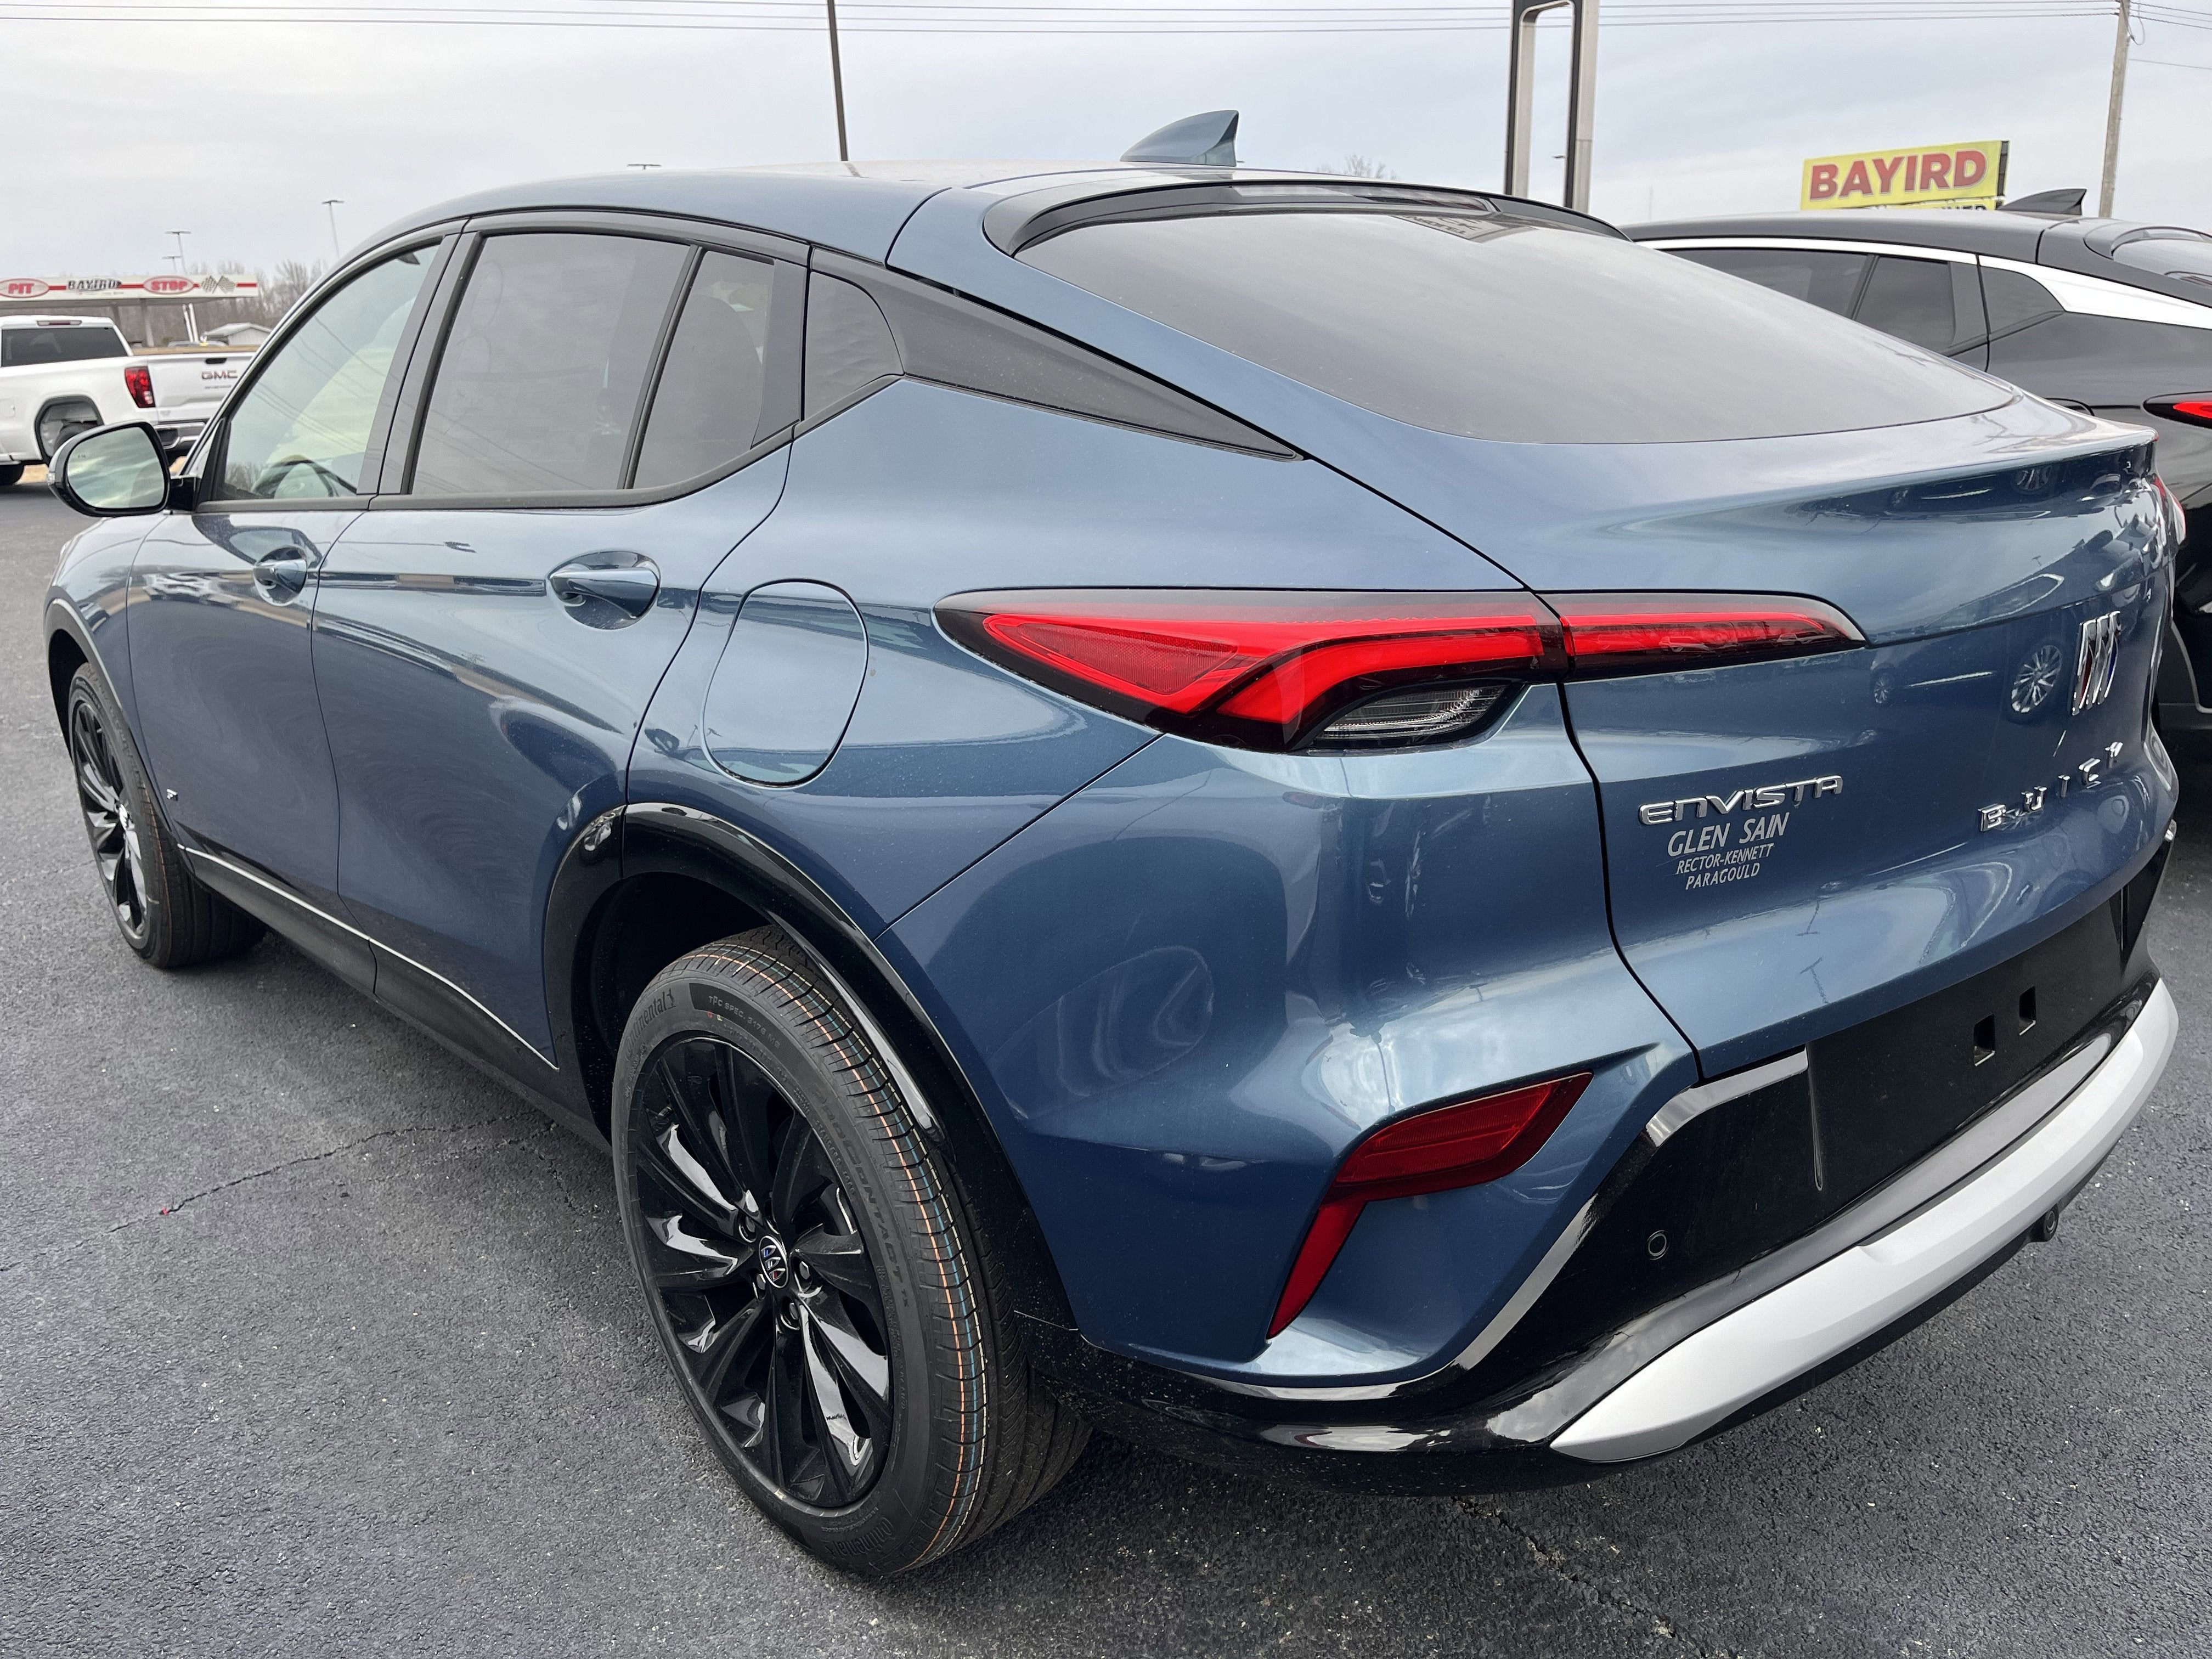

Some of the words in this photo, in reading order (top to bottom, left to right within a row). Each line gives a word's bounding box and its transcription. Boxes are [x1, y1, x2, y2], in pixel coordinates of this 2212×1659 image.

[1809, 149, 1988, 201] BAYIRD
[8, 282, 35, 295] PIT
[67, 279, 122, 291] BAYIRD
[151, 280, 188, 291] STOP
[201, 369, 238, 379] GMC
[1638, 775, 1843, 826] ENVISTA
[1667, 823, 1731, 857] GLEN
[1739, 812, 1790, 844] SAIN
[1676, 843, 1775, 875] RECTOR-KENNETT
[1685, 862, 1761, 890] PARAGOULD
[708, 994, 724, 1009] TPC
